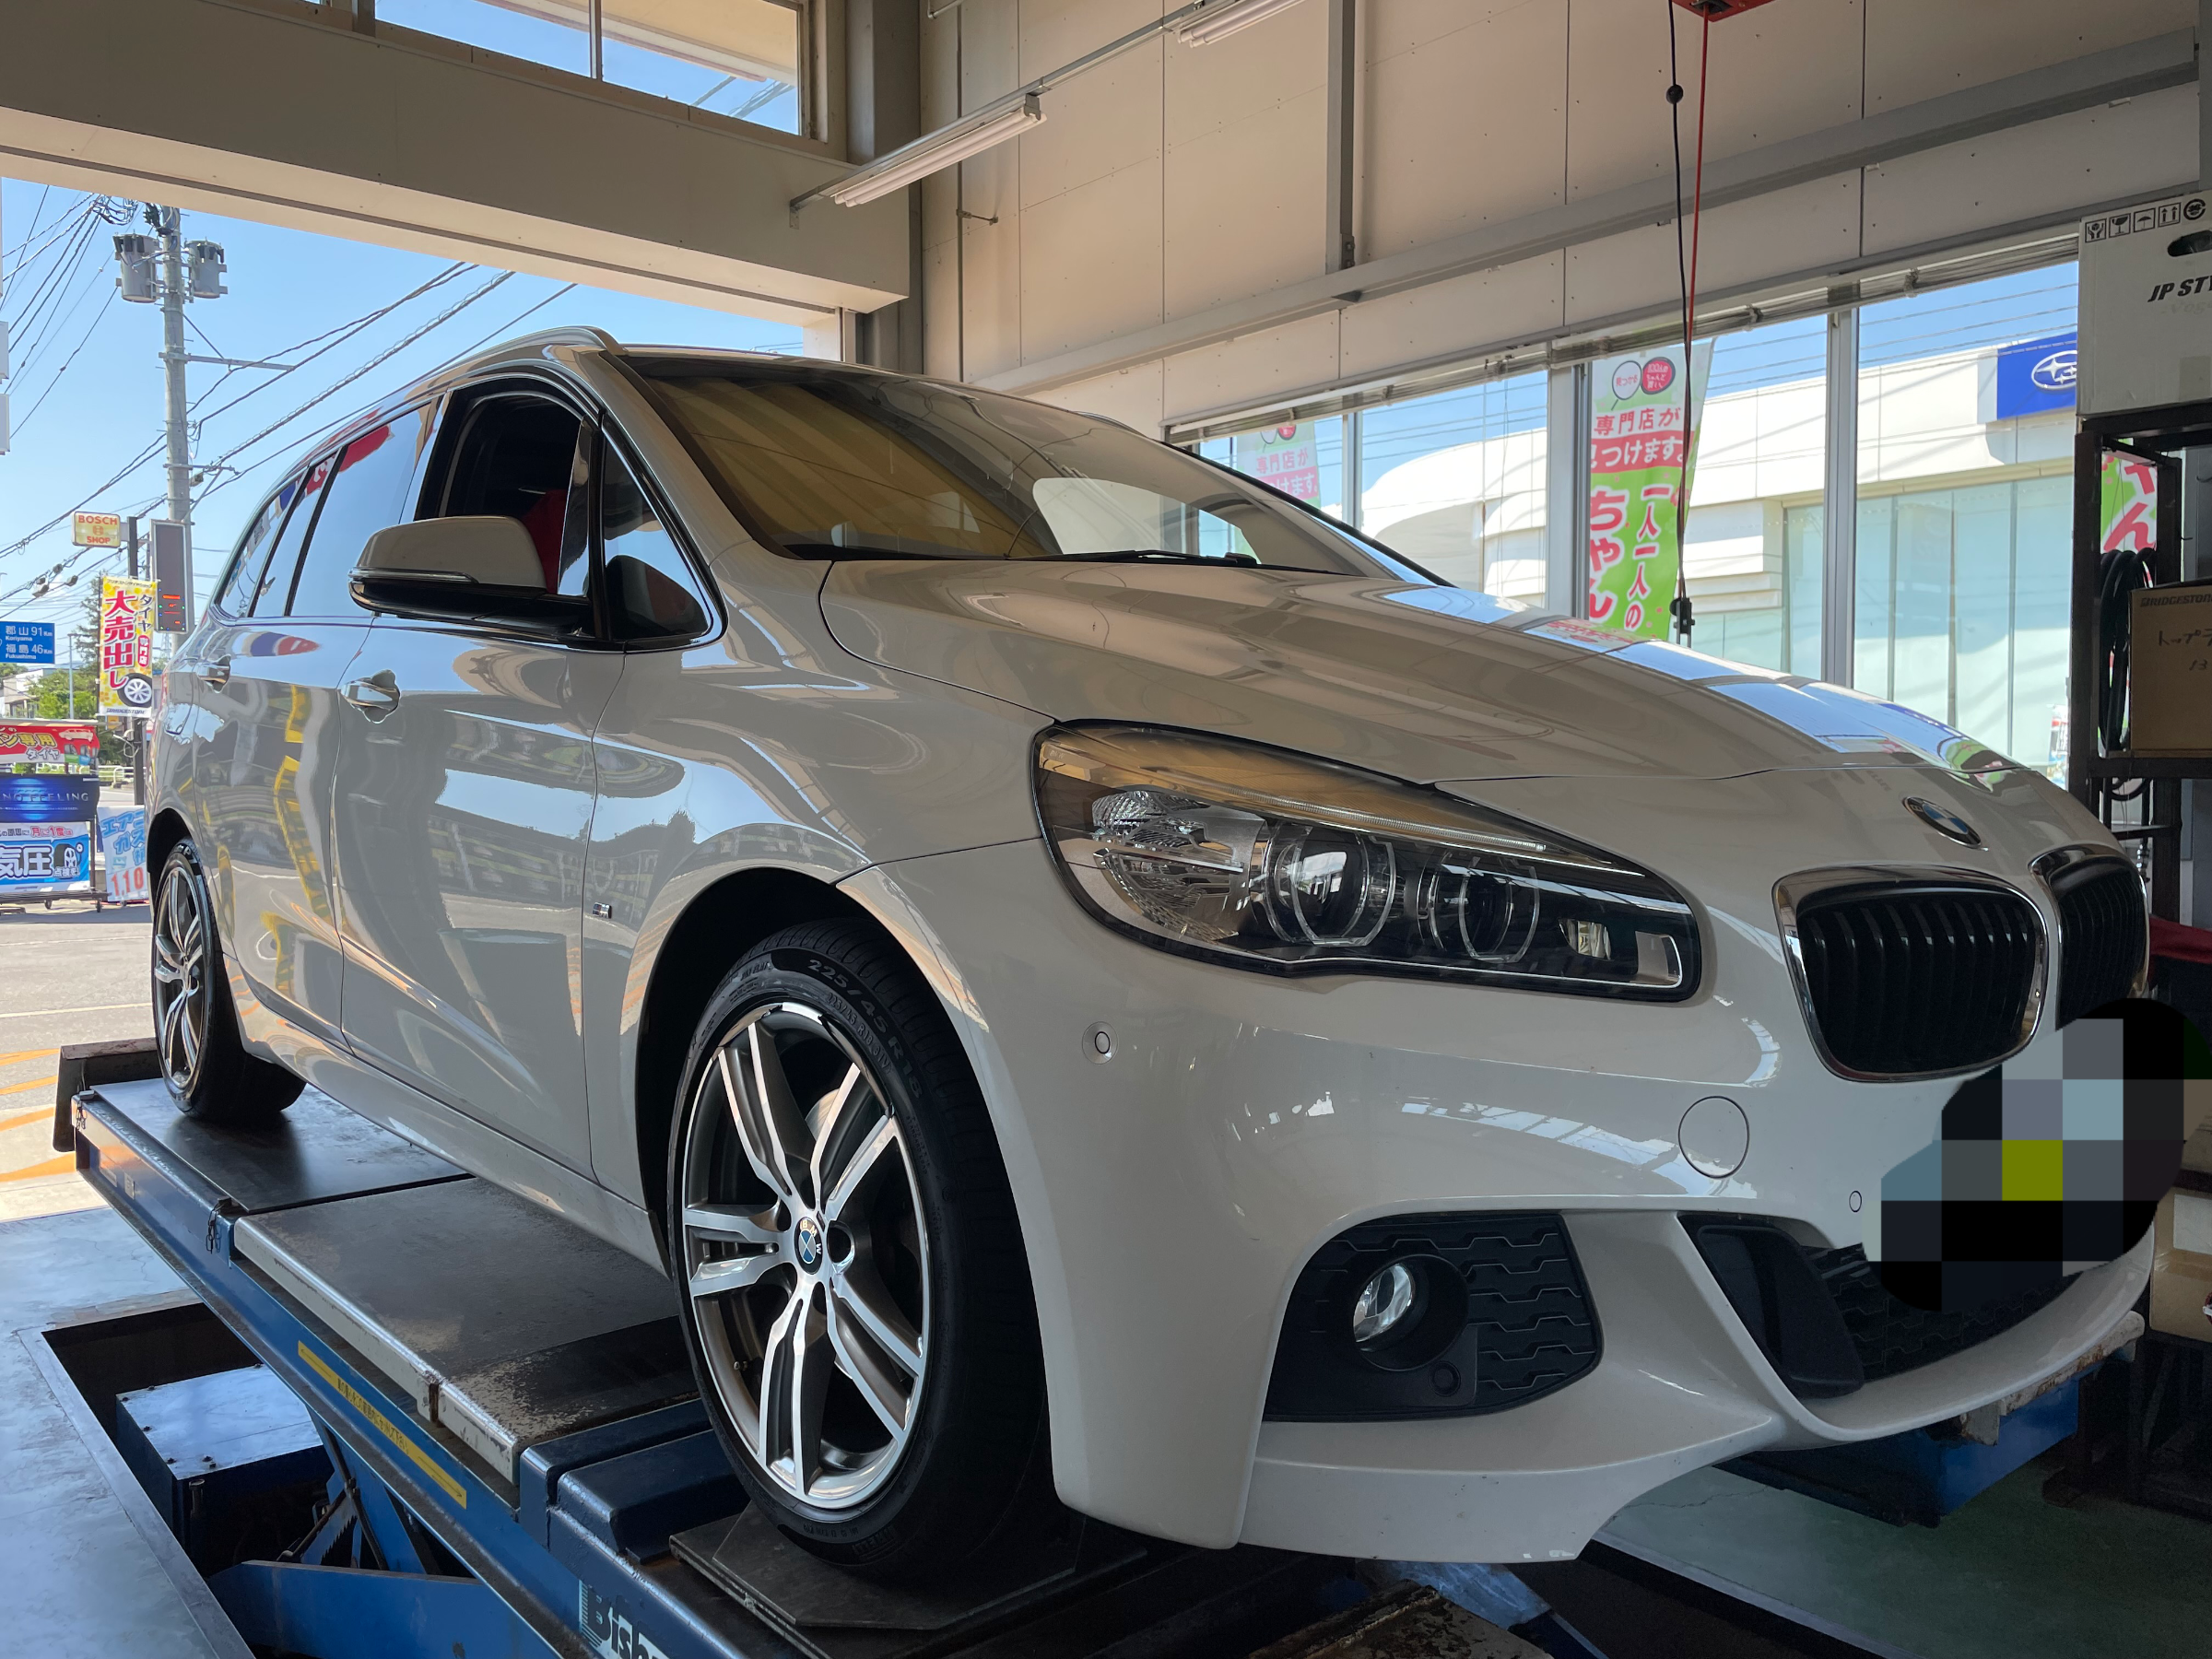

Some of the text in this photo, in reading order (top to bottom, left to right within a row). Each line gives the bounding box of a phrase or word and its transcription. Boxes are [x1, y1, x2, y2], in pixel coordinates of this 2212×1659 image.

[2147, 276, 2212, 302] JP ST
[1594, 407, 1681, 436] 専門店が
[1256, 447, 1308, 474] 専門店が
[1591, 436, 1683, 468] つけます。
[78, 515, 117, 525] BOSCH
[1625, 487, 1670, 629] 一人一人の
[138, 594, 153, 632] タイヤ
[104, 590, 135, 688] 大売出し
[26, 748, 60, 760] タイヤ
[30, 793, 88, 802] FEELING
[802, 1219, 822, 1254] BMW
